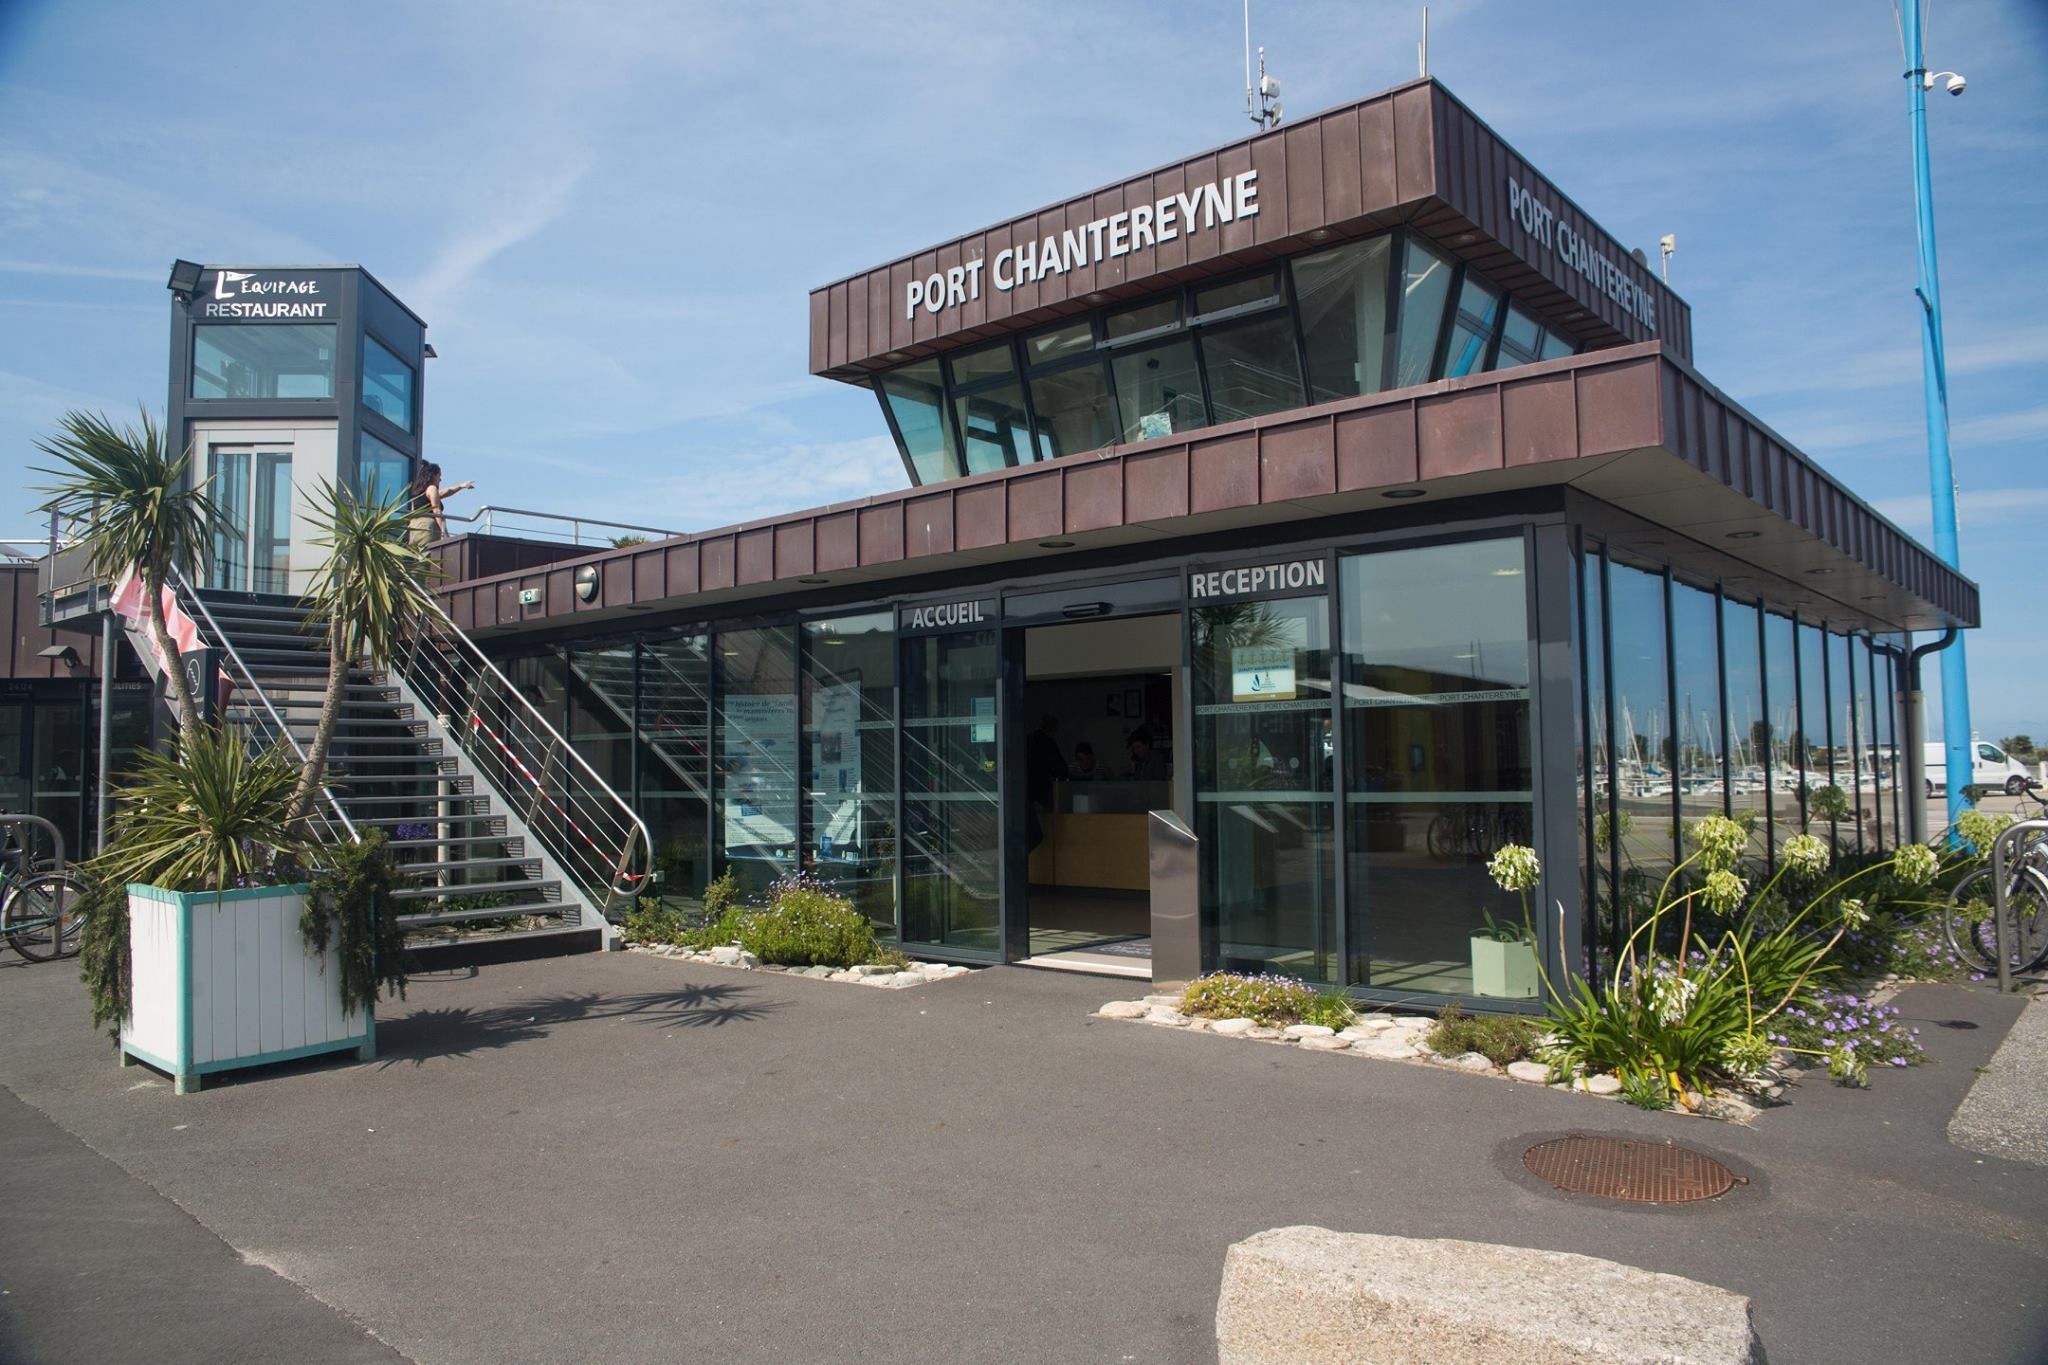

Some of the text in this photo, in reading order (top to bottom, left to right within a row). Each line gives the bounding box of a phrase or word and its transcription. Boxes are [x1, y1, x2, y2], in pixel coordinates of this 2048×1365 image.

[906, 169, 1259, 320] PORT CHANTEREYNE
[1508, 176, 1656, 332] PORT CHANTEREYNE
[205, 303, 326, 317] RESTAURANT
[1192, 559, 1325, 598] RECEPTION
[912, 601, 984, 629] ACCUEIL
[1439, 690, 1521, 702] PORT CHANTEREYNE
